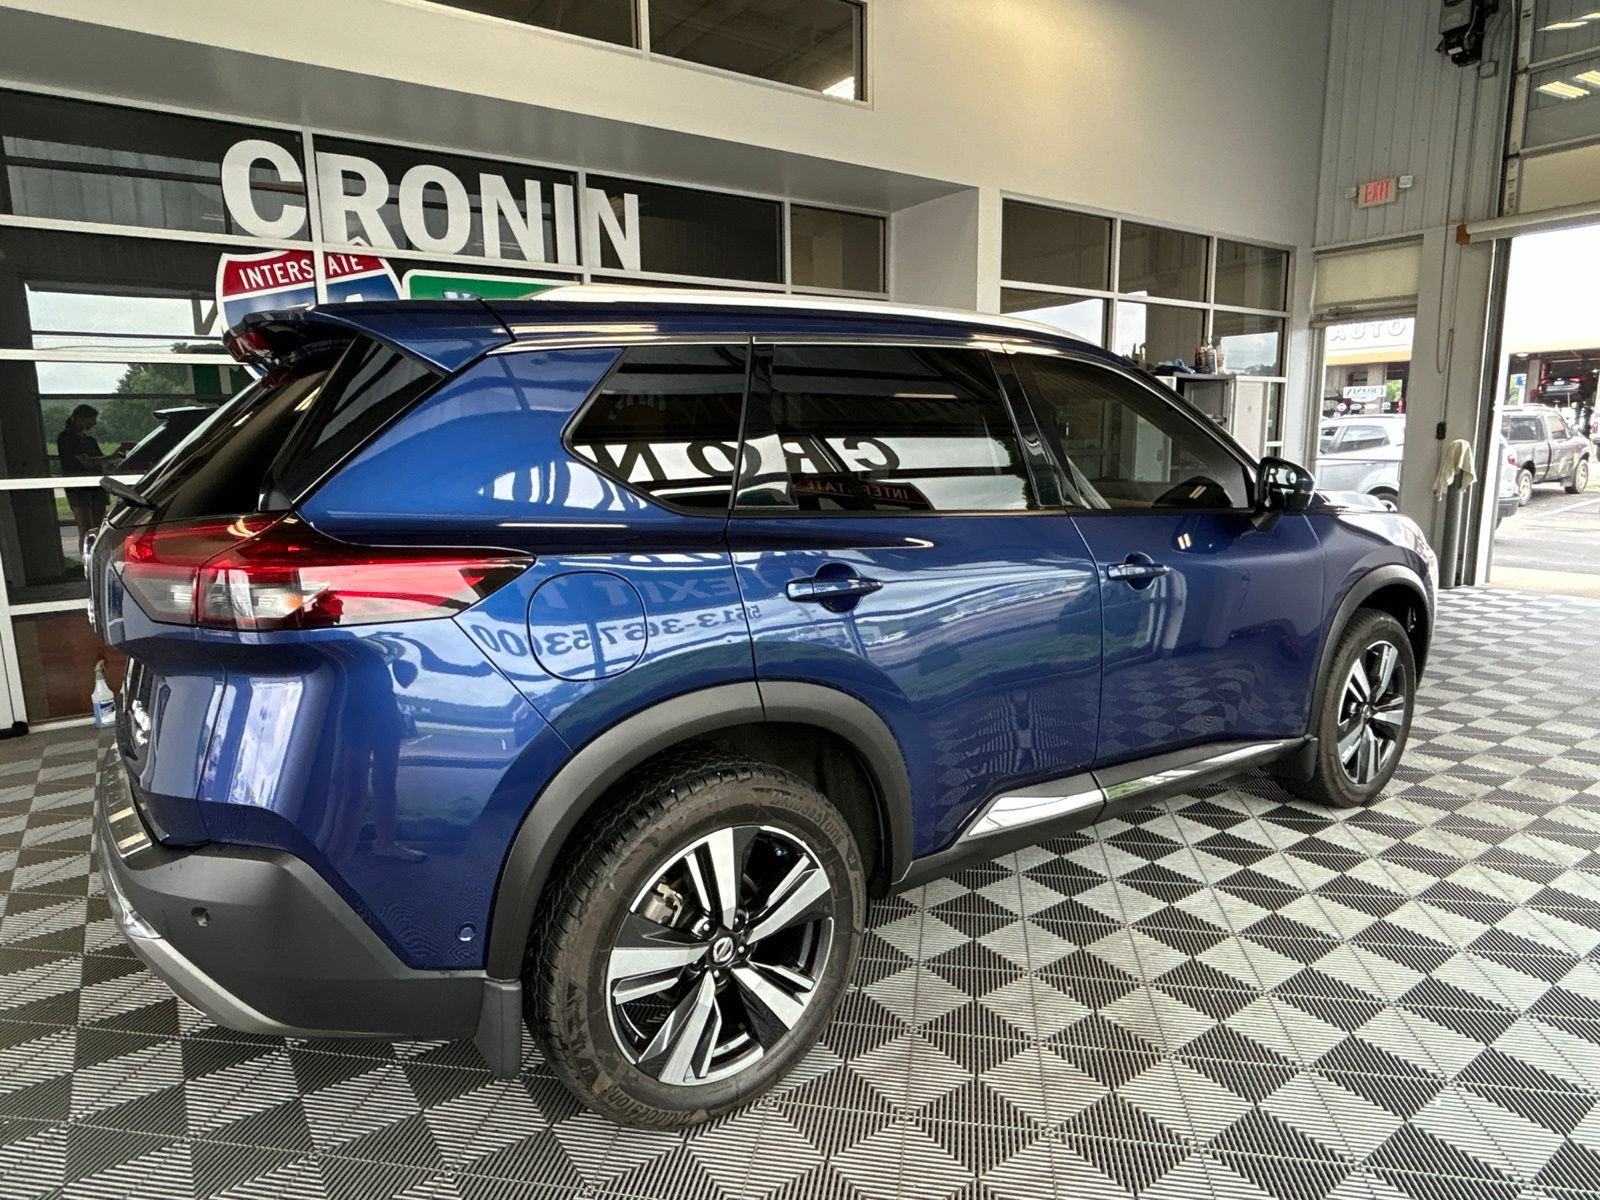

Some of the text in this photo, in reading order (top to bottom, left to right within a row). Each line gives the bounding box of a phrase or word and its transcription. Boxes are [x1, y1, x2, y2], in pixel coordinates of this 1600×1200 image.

[221, 139, 641, 271] CRONIN
[1364, 179, 1390, 203] EXIT
[239, 254, 364, 290] INTERSATE
[1330, 320, 1405, 341] AUTO
